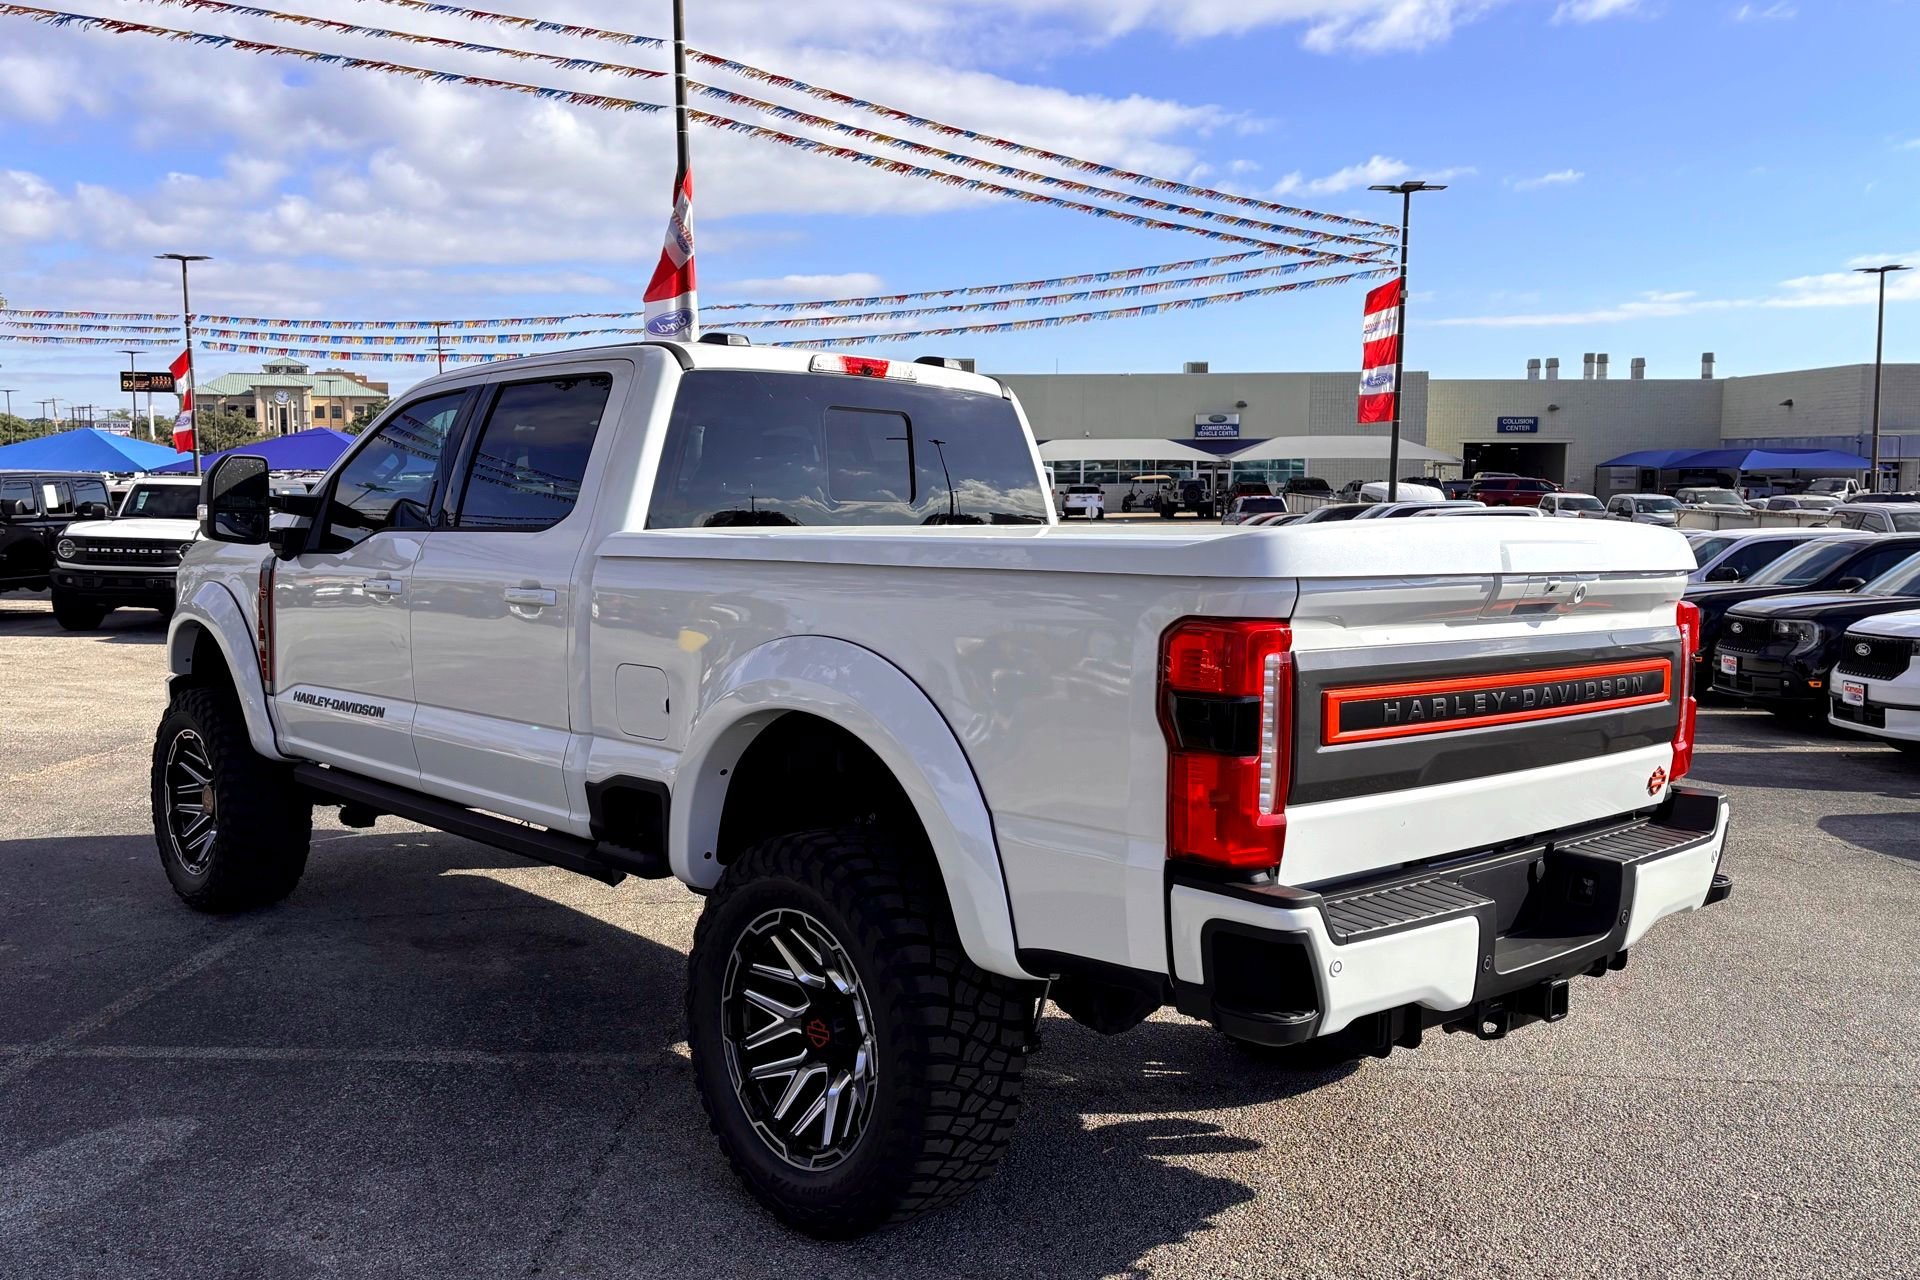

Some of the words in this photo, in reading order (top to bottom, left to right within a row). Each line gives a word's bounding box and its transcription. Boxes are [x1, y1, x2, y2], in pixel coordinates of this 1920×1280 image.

[269, 366, 282, 374] IBC
[286, 366, 304, 374] Bank
[293, 690, 386, 718] HARLEY-DAVIDSON
[1382, 675, 1645, 724] HARLEY-DAVIDSON
